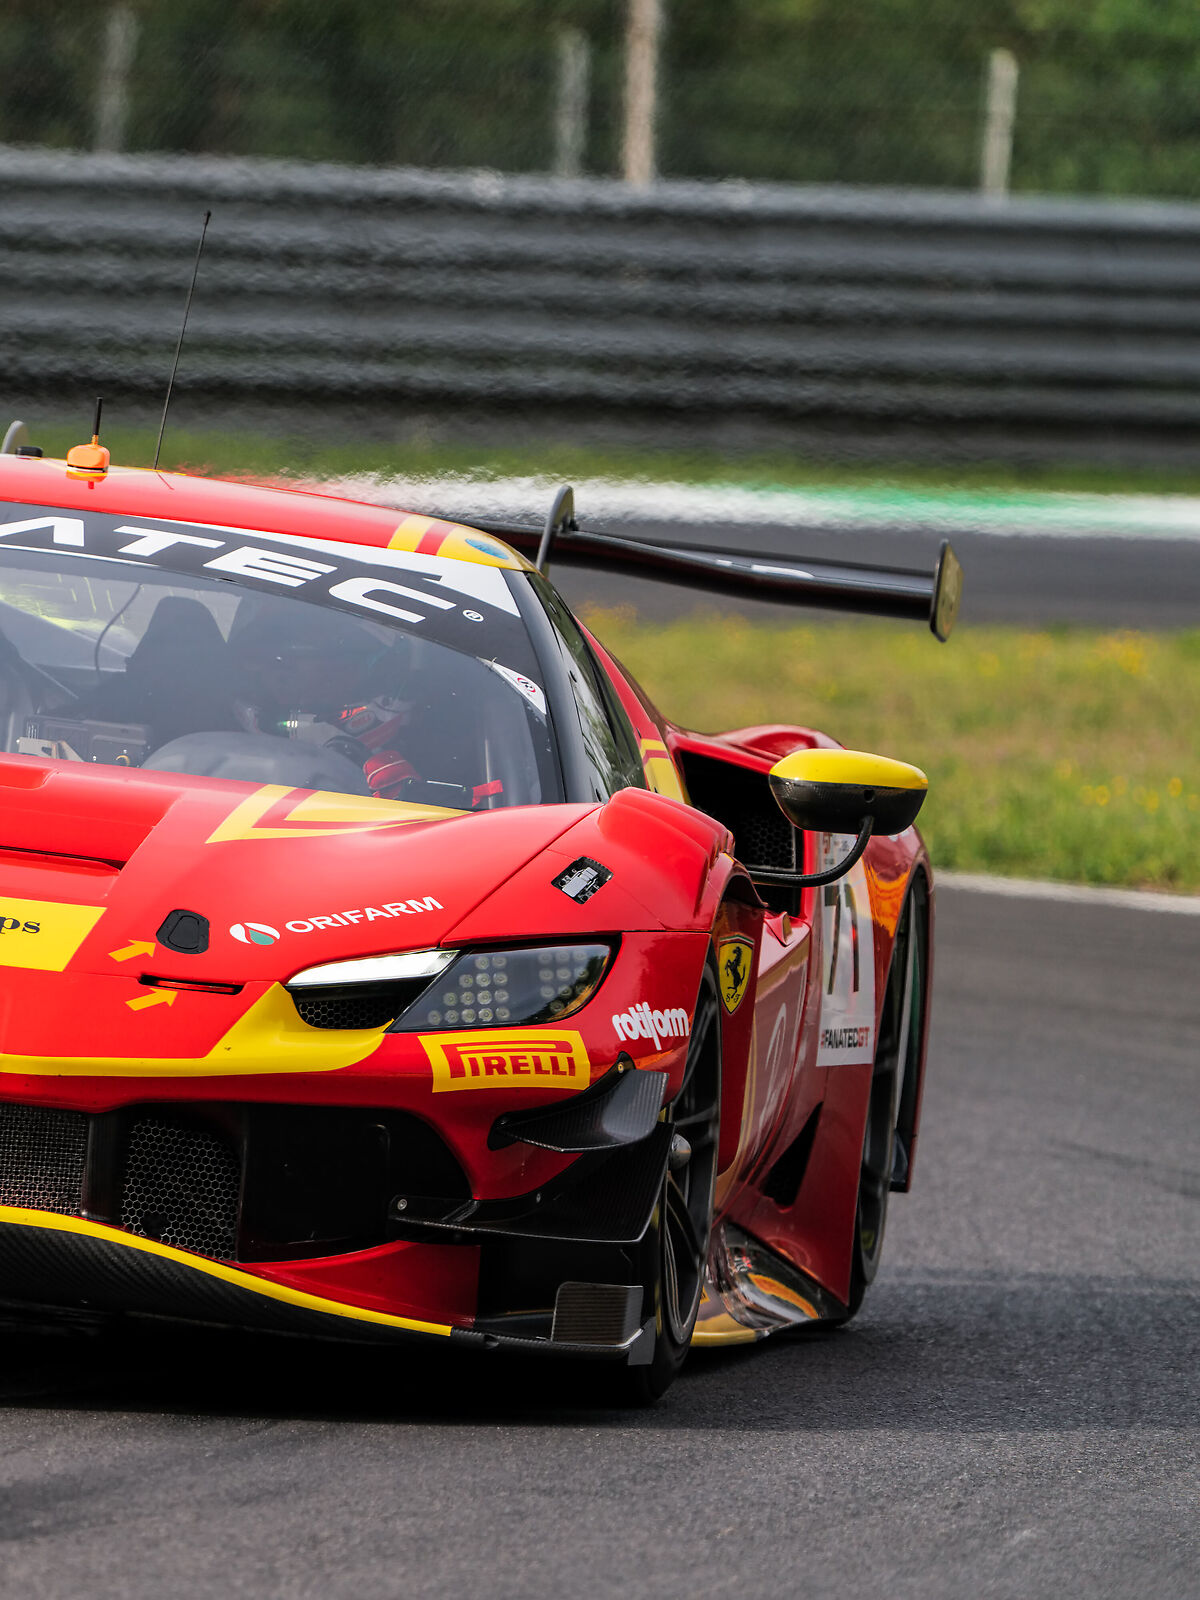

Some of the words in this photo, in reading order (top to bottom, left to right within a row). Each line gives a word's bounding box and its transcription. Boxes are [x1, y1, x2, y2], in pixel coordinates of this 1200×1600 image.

[285, 896, 444, 934] ORIFARM
[823, 882, 860, 996] 71
[612, 1001, 690, 1051] rotiform
[439, 1040, 577, 1079] PIRELLI
